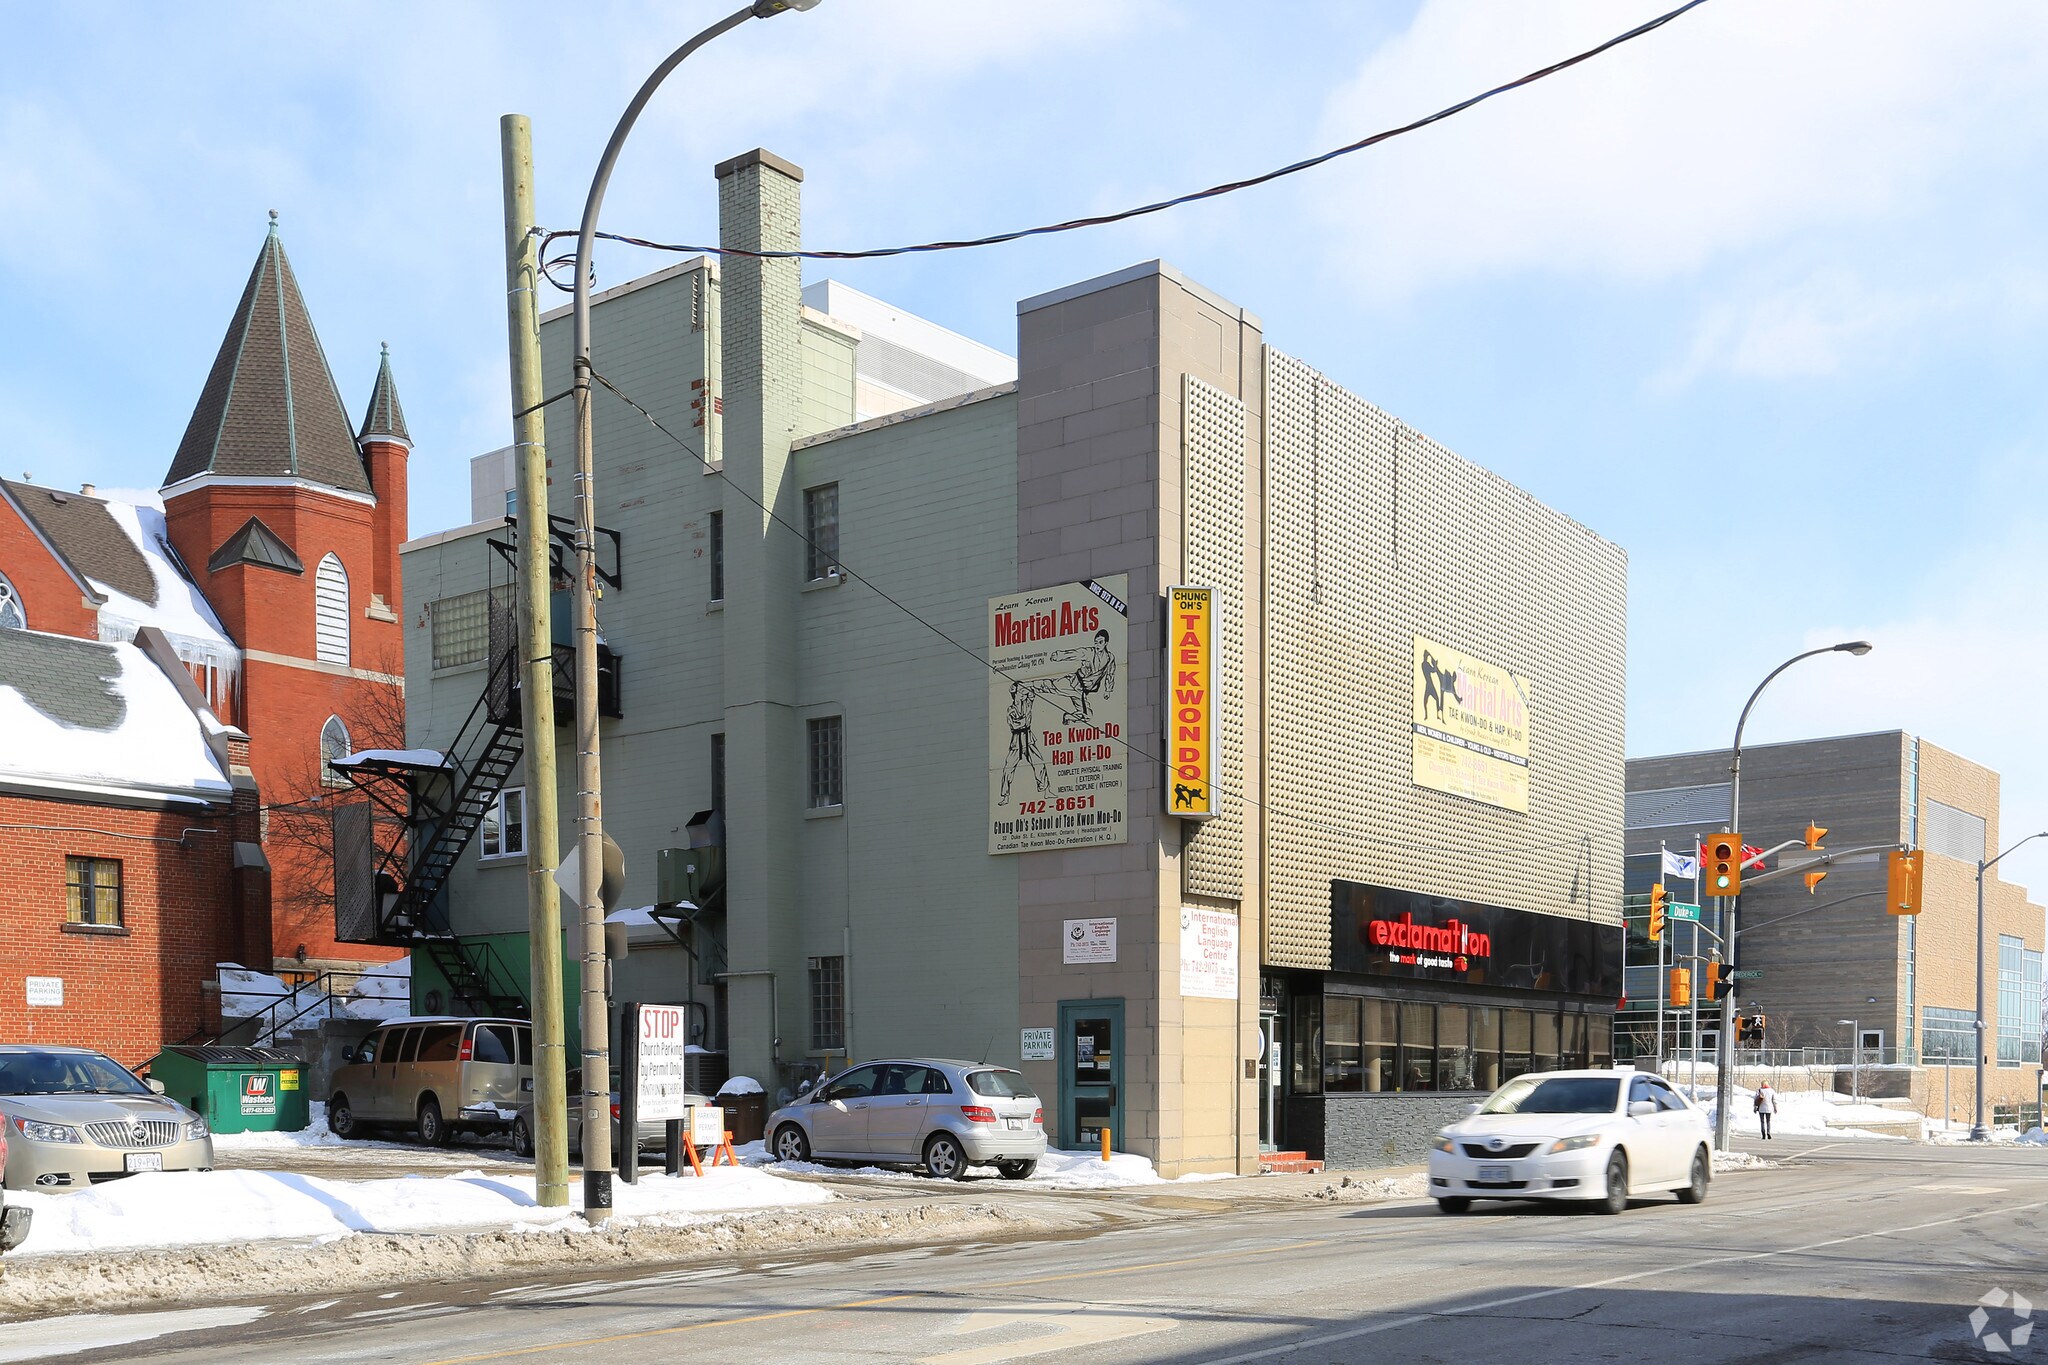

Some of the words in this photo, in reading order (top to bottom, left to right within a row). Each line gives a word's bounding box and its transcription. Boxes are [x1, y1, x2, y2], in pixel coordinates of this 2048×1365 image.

[995, 603, 1019, 611] Learn
[1024, 596, 1053, 607] Korean
[1174, 592, 1207, 602] CHUNG
[1180, 601, 1202, 610] OH'S
[995, 609, 1056, 647] Martial
[1060, 601, 1099, 636] Arts
[1179, 615, 1200, 665] TAE
[1458, 659, 1476, 678] Learn
[1478, 666, 1499, 685] Korean
[1176, 672, 1204, 742] KWON
[1457, 672, 1496, 718] Martial
[1500, 689, 1522, 727] Arts
[1449, 706, 1459, 720] TAE
[1461, 711, 1488, 730] KWON-DO
[1489, 722, 1493, 732] &
[1494, 723, 1505, 735] HAP
[1507, 728, 1522, 742] KI-DO
[1042, 731, 1062, 746] Tae
[1068, 722, 1120, 743] Kwon-Do
[1417, 725, 1427, 735] MEN,
[1427, 728, 1442, 739] WOMEN
[1446, 735, 1465, 746] CHILDREN
[1467, 742, 1480, 752] YOUNG
[1509, 754, 1526, 766] WELCOME
[1052, 750, 1074, 765] Hap
[1080, 744, 1111, 762] Ki-Do
[1058, 768, 1080, 776] COMPLETE
[1081, 766, 1100, 774] PHYSICAL
[1103, 763, 1122, 772] TRAINING
[1178, 747, 1201, 781] DO
[1058, 785, 1074, 793] MENTAL
[1019, 795, 1095, 815] 742-8651
[994, 822, 1013, 835] Chung
[1016, 818, 1028, 832] Oh's
[1032, 816, 1053, 831] School
[1056, 815, 1062, 828] of
[1064, 814, 1074, 828] Tae
[1077, 812, 1094, 826] Kwon
[1097, 810, 1122, 825] Moo-Do
[997, 842, 1018, 850] Canadian
[1045, 838, 1064, 846] Moo-Do
[1067, 836, 1093, 844] Federation
[1191, 911, 1237, 927] International
[1674, 906, 1689, 918] Duke
[1202, 924, 1228, 938] English
[1198, 935, 1232, 951] Language
[1204, 948, 1228, 960] Centre
[1390, 952, 1400, 963] the
[1400, 954, 1416, 964] mark
[1416, 954, 1423, 965] of
[1424, 956, 1438, 968] good
[1438, 958, 1453, 968] taste
[644, 1009, 679, 1038] STOP
[1024, 1032, 1051, 1040] PRIVATE
[640, 1042, 660, 1056] Church
[661, 1042, 682, 1060] Parking
[1024, 1041, 1052, 1049] PARKING
[641, 1062, 648, 1080] by
[649, 1062, 669, 1076] Permit
[670, 1062, 682, 1080] Only
[242, 1095, 273, 1104] Wasteco
